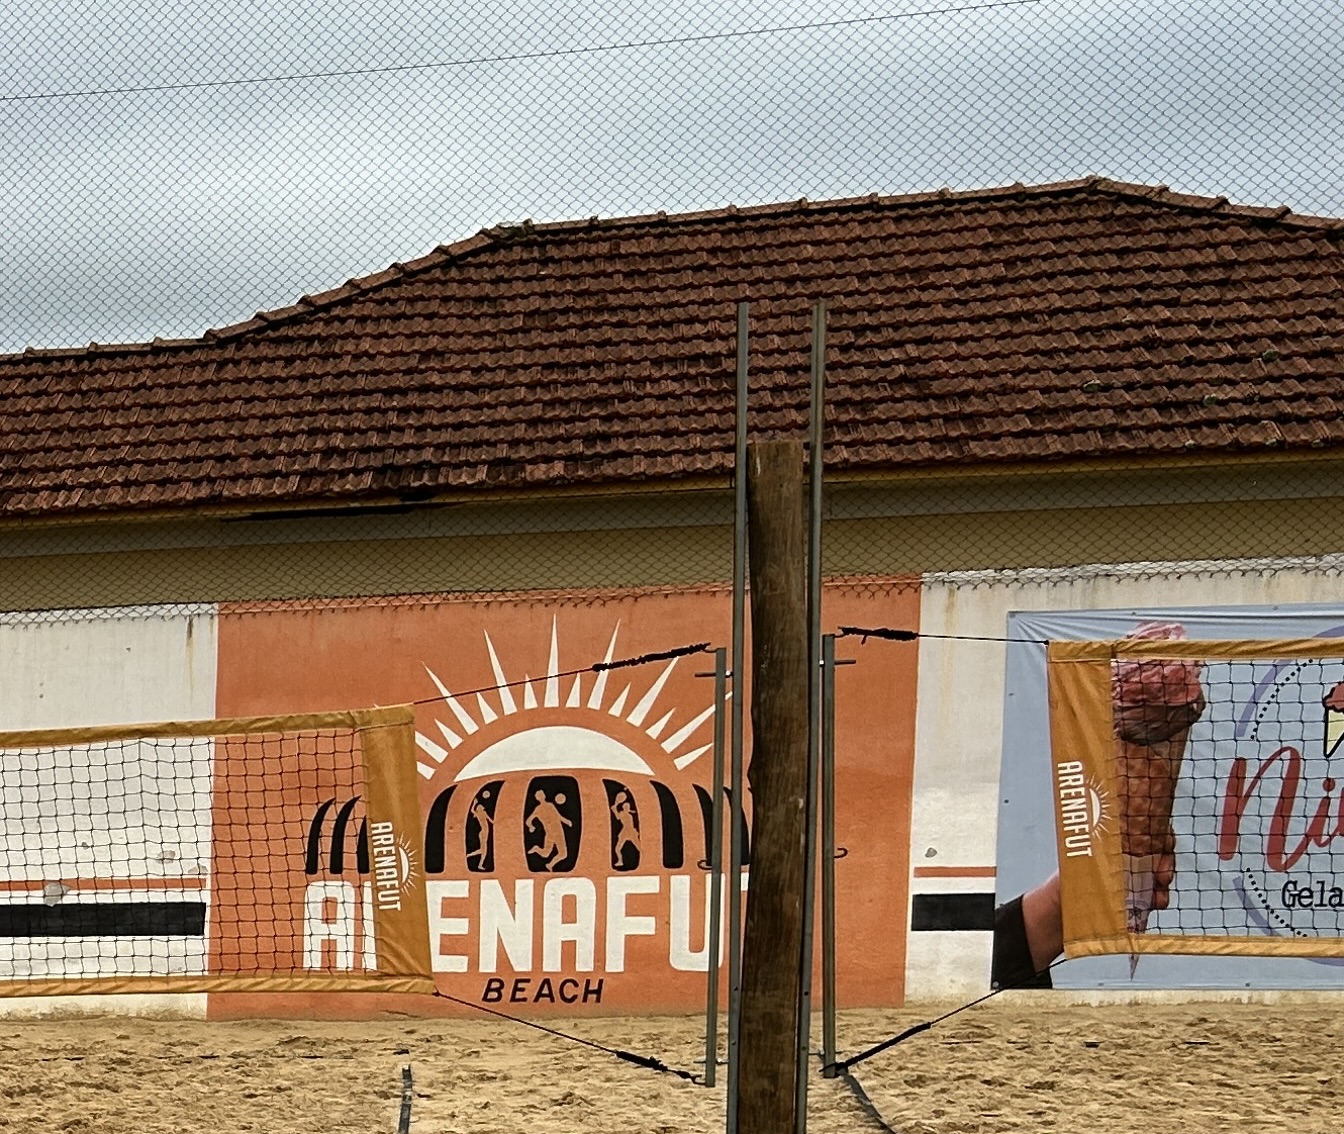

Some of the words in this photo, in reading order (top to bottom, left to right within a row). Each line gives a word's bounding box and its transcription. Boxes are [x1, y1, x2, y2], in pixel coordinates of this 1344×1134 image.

[1057, 761, 1093, 857] ARENAFUT
[371, 821, 401, 911] ARENAFUT
[302, 872, 750, 972] AENAFU
[481, 977, 604, 1004] BEACH
